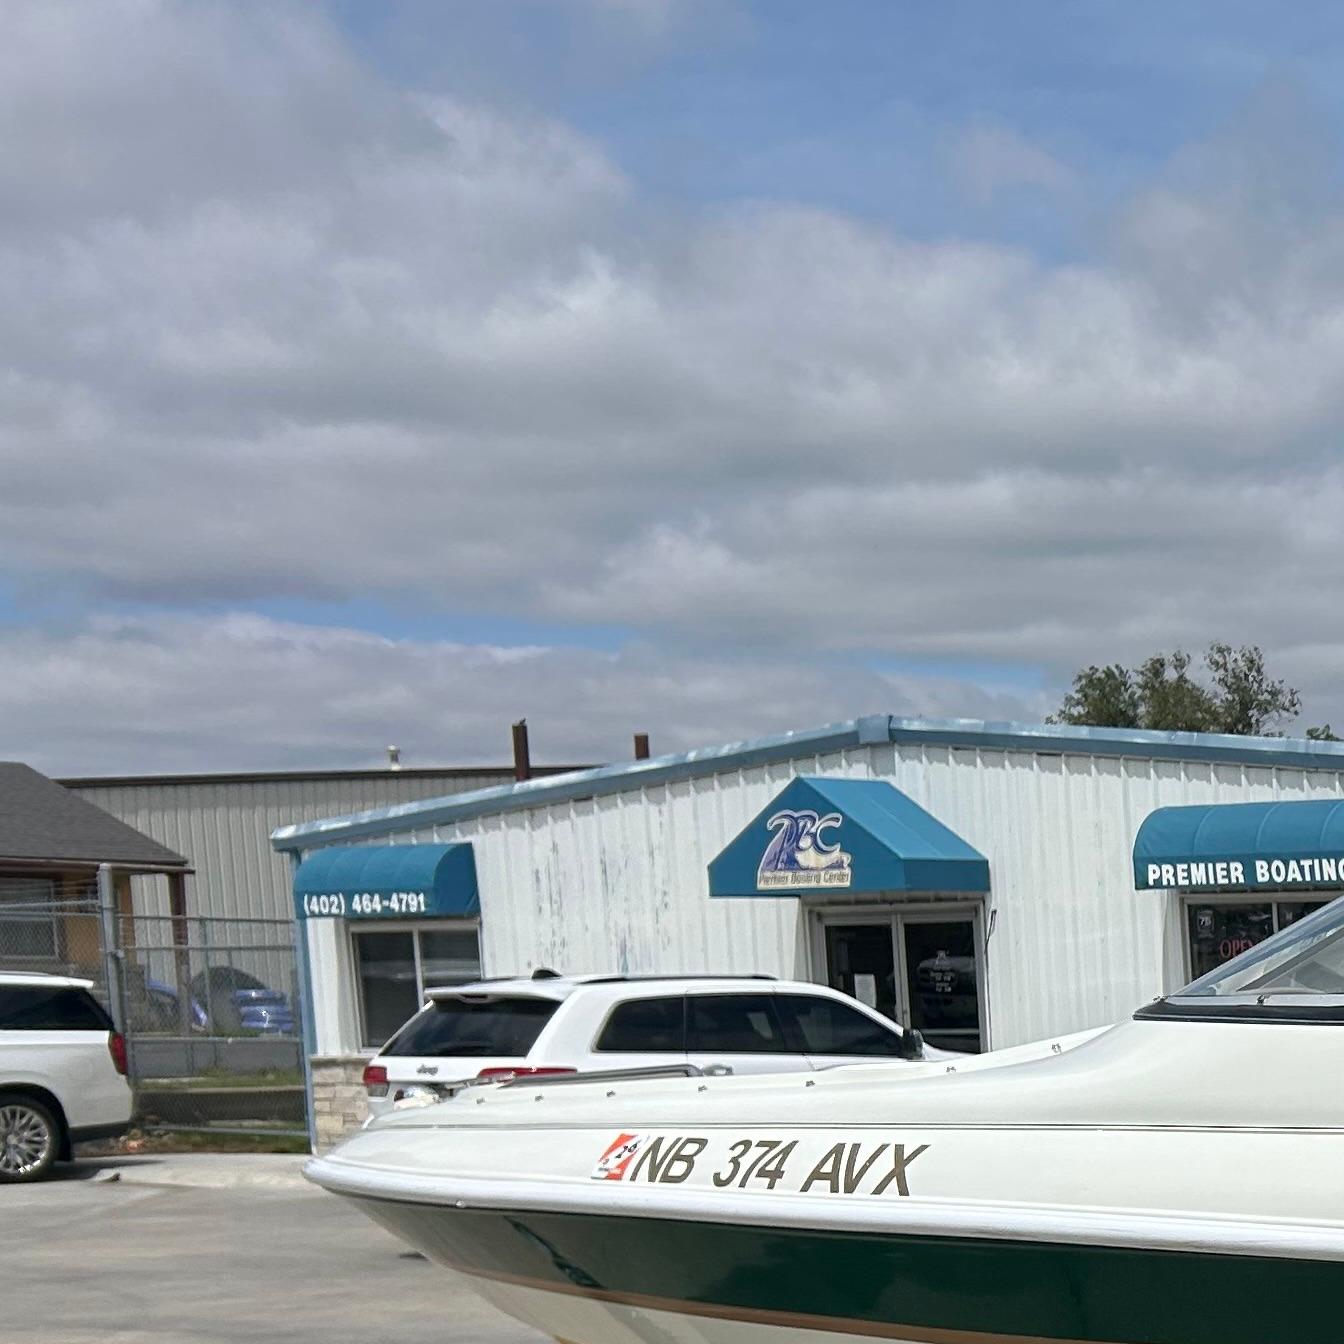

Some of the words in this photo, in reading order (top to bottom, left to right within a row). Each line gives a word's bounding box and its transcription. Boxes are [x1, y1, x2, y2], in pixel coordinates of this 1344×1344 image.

[1147, 862, 1244, 886] PREMIER
[303, 893, 346, 916] (402)
[352, 892, 425, 914] 464-4791
[630, 1136, 709, 1184] NB
[712, 1139, 799, 1190] 374
[799, 1142, 931, 1197] AVX
